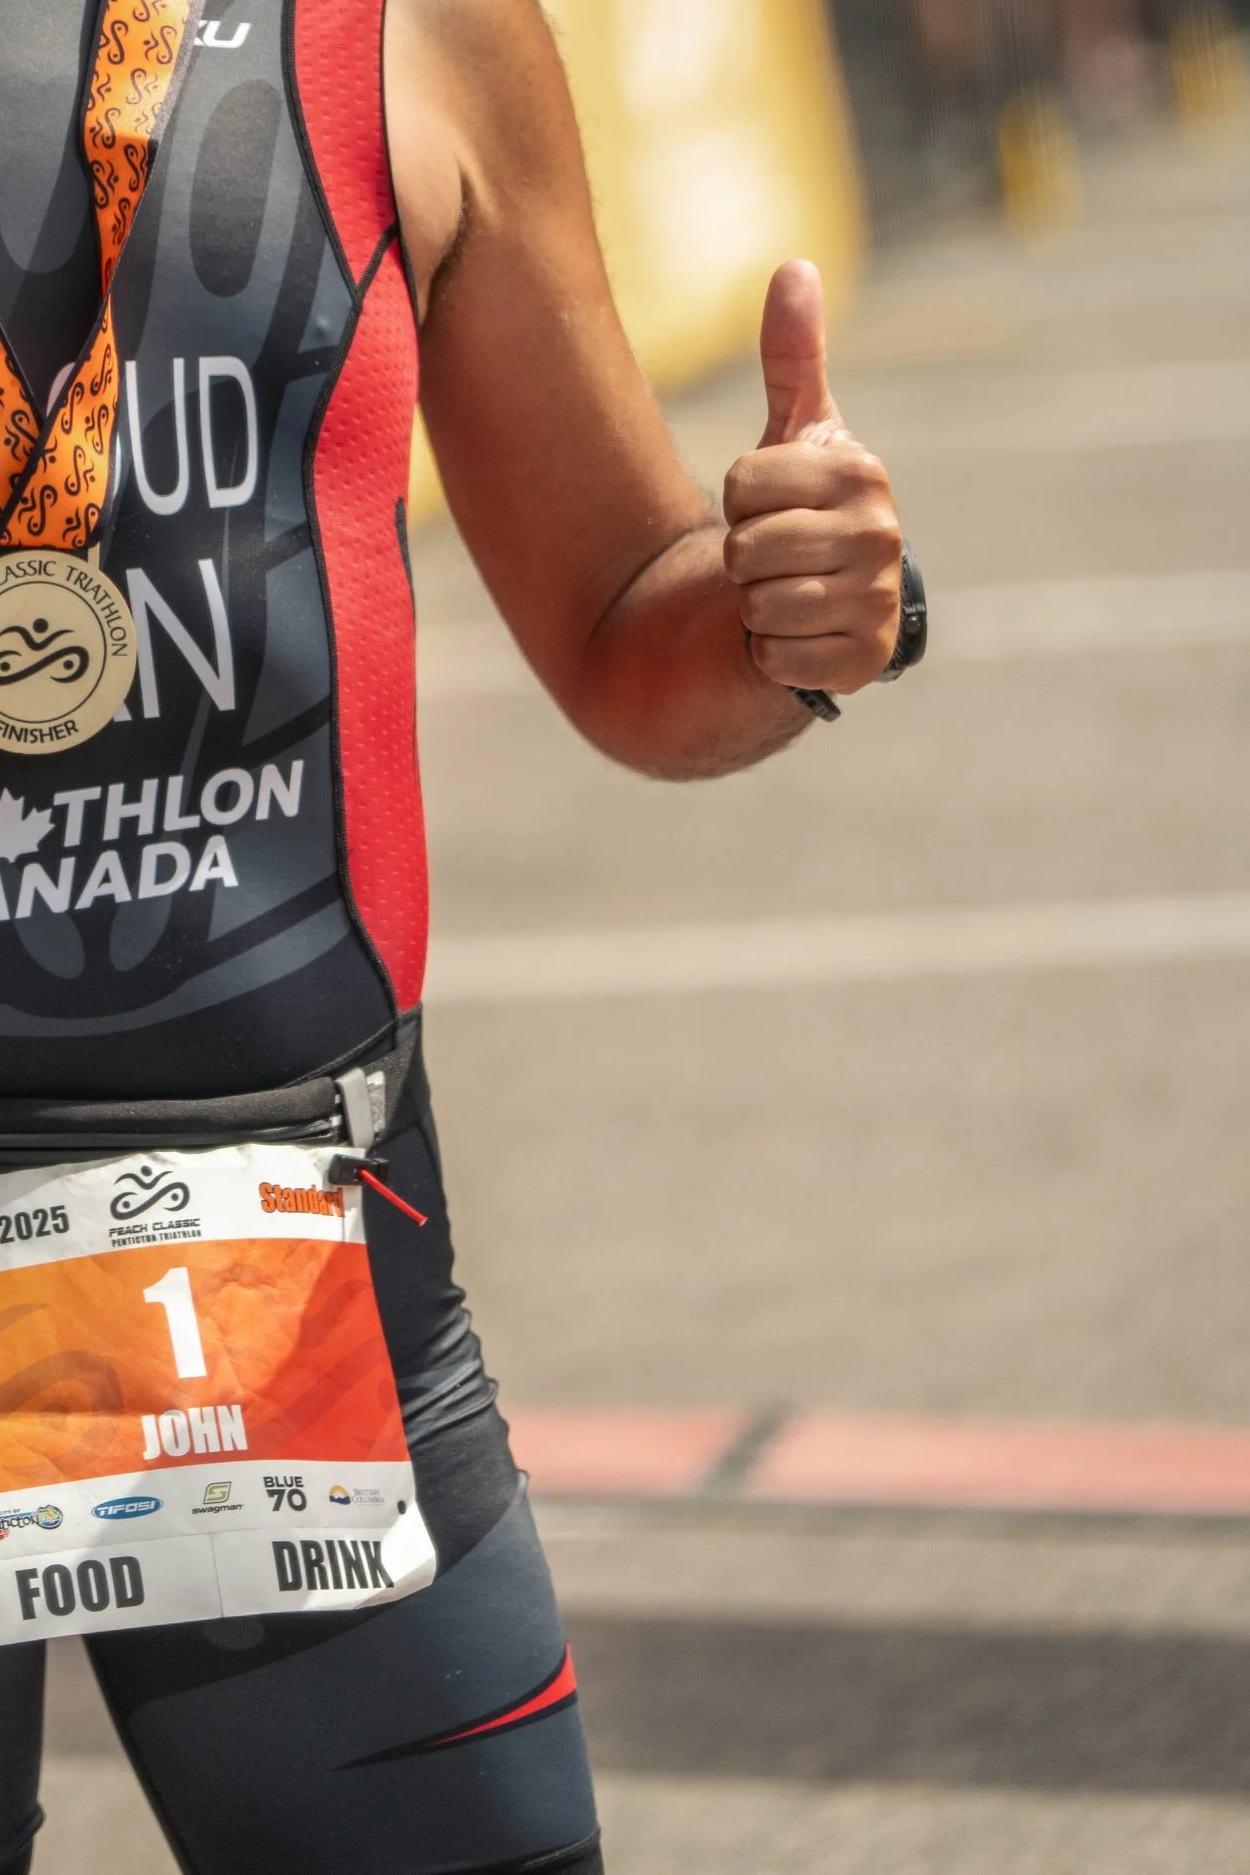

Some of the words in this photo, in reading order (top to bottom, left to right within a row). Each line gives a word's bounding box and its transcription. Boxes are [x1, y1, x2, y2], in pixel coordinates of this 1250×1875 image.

[65, 565, 128, 657] TRIATHLON
[259, 1182, 344, 1218] Standard
[109, 1223, 148, 1237] PEACH
[152, 1218, 201, 1231] CLASSIC
[111, 1235, 157, 1247] PENTICTON
[159, 1229, 202, 1241] TRIATHLON
[143, 1266, 207, 1379] 1
[141, 1404, 248, 1460] JOHN
[263, 1476, 304, 1488] BLUE
[96, 1500, 156, 1516] TIFOSI
[192, 1504, 243, 1514] swagman
[266, 1488, 308, 1512] 70
[272, 1539, 394, 1592] DRINK
[15, 1556, 145, 1621] FOOD
